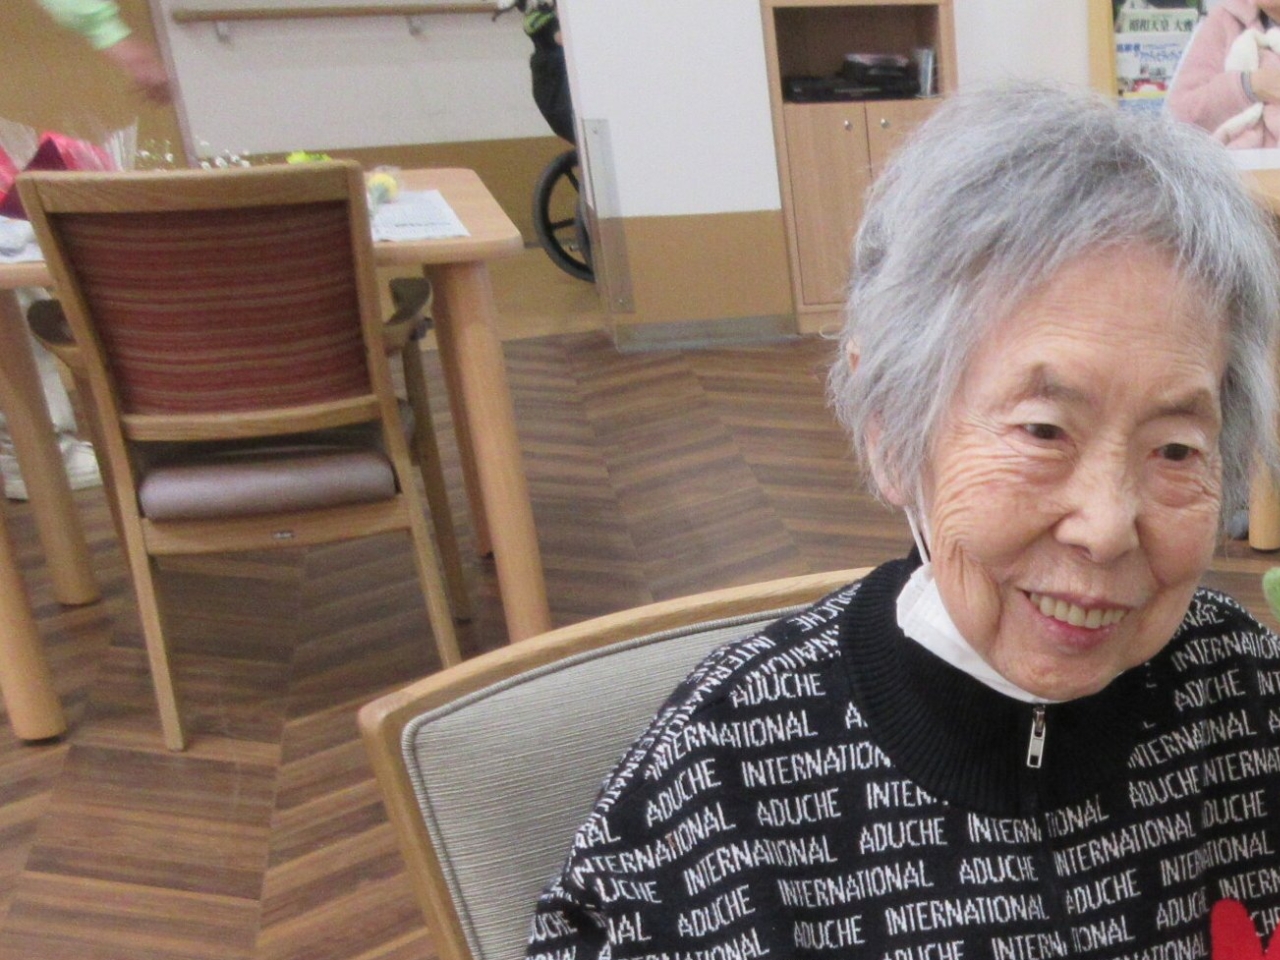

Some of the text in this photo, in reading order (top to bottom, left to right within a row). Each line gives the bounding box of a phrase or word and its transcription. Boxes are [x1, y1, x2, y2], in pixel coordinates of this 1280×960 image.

[731, 672, 827, 709] ADUCHE
[646, 758, 722, 828] ADUCHE
[683, 833, 839, 896] INTERNATIONAL
[859, 816, 949, 855] ADUCHE
[1128, 763, 1202, 809] ADUCHE
[756, 787, 842, 827] ADUCHE
[677, 883, 757, 938] ADUCHE
[777, 858, 935, 909] INTERNATIONAL
[957, 854, 1040, 885] ADUCHE
[1052, 810, 1197, 878] INTERNATIONAL
[793, 914, 866, 951] ADUCHE
[883, 893, 1051, 937] INTERNATIONAL
[1065, 868, 1142, 916] ADUCHE
